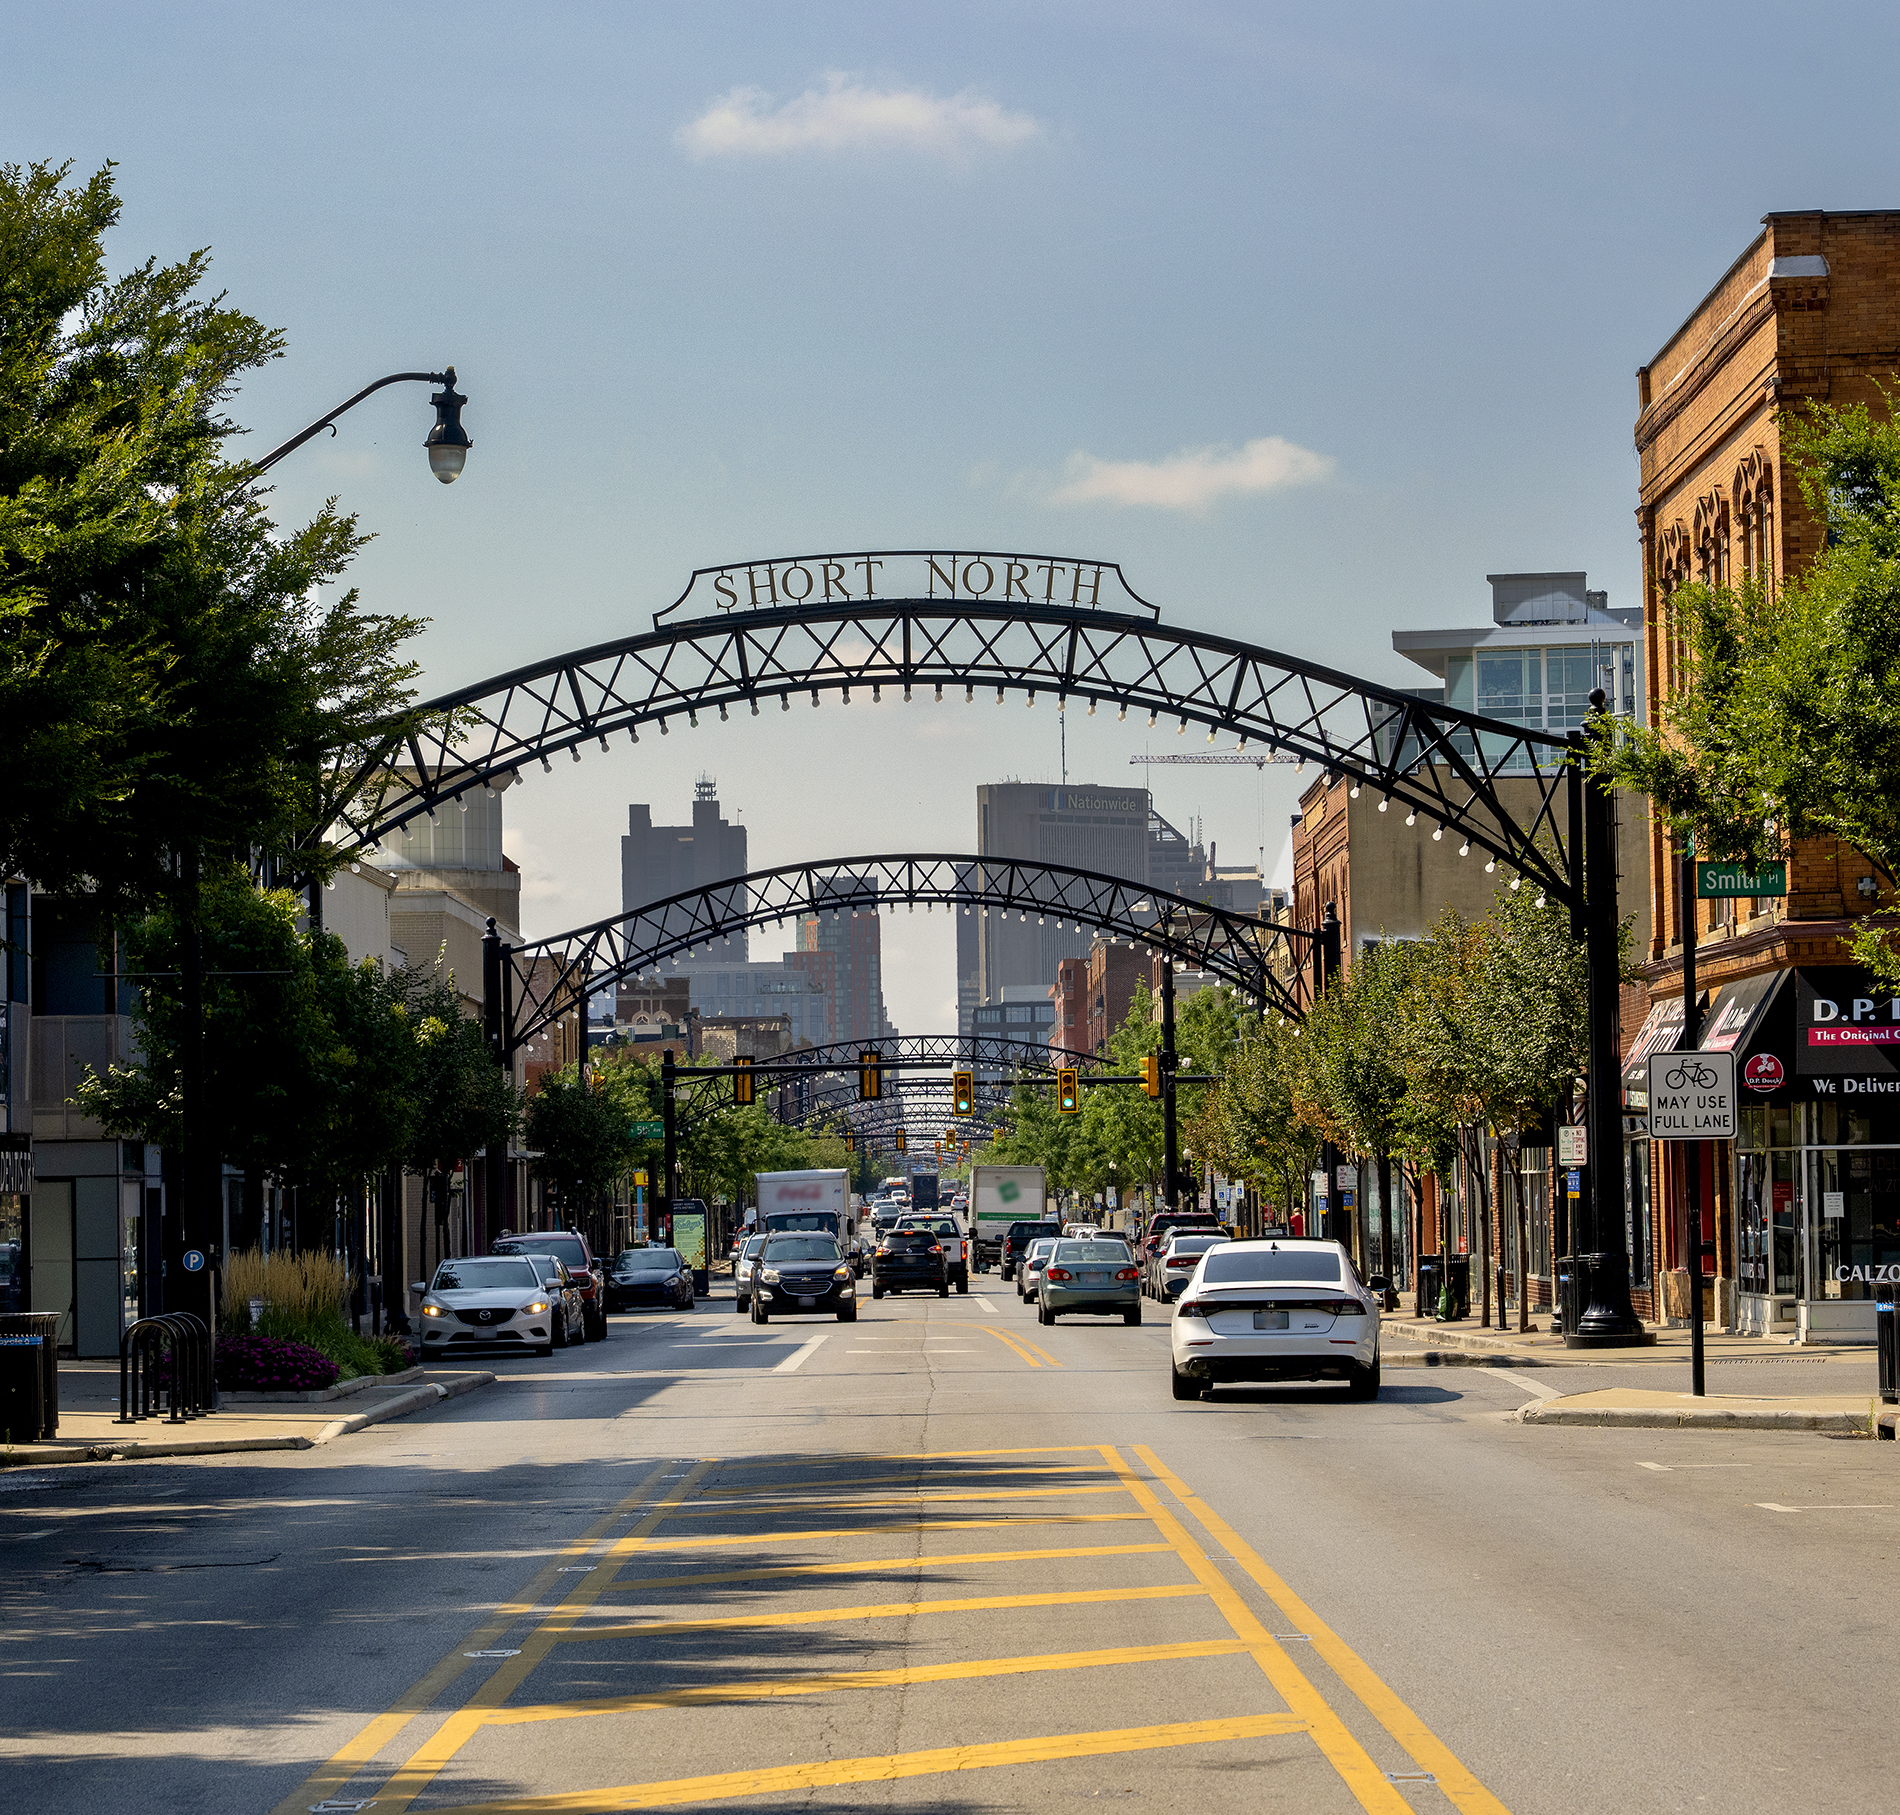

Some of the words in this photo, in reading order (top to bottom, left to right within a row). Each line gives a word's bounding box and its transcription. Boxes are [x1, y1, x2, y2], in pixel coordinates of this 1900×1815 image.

[714, 560, 884, 610] SHORT
[926, 559, 1106, 611] NORTH
[1068, 794, 1137, 811] Nationwide
[1705, 870, 1761, 890] Smith
[1813, 998, 1876, 1022] D.P.
[1812, 1079, 1836, 1093] We
[1657, 1096, 1690, 1110] MAY
[1697, 1095, 1727, 1109] USE
[1655, 1115, 1689, 1129] FULL
[1695, 1114, 1730, 1128] LANE
[190, 1254, 199, 1268] P
